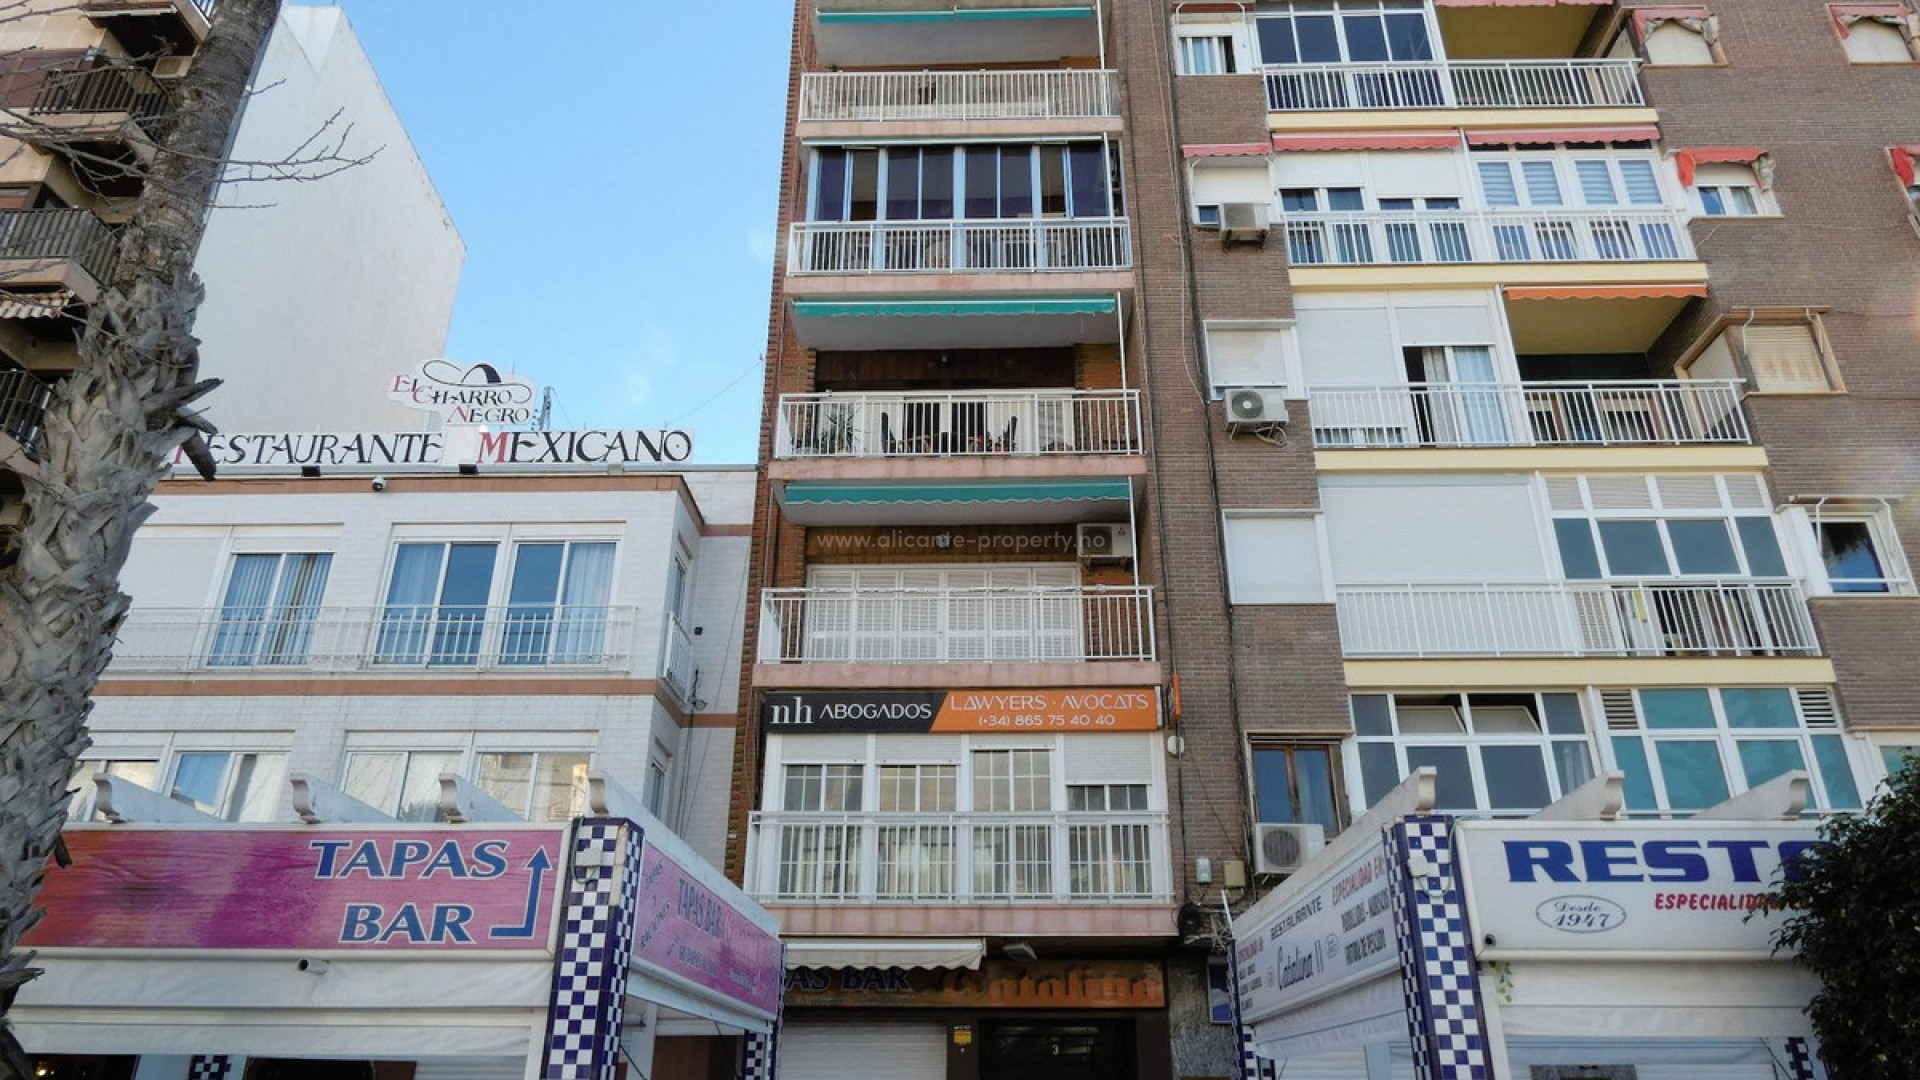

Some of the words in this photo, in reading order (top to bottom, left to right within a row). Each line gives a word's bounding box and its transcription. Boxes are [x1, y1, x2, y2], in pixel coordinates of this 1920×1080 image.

[412, 384, 513, 405] CHARRO
[446, 404, 530, 423] NEGRO
[476, 429, 692, 464] MEXICANO
[769, 696, 813, 725] nh
[819, 703, 932, 719] ABOGADOS
[951, 694, 1047, 711] LAWYERS
[1060, 693, 1148, 710] AVOCATS
[1015, 716, 1043, 727] 865
[1048, 715, 1065, 726] 75
[1070, 715, 1090, 726] 40
[1095, 715, 1115, 726] 40
[309, 840, 510, 880] TAPAS
[677, 878, 704, 929] TAPAS
[338, 902, 478, 944] BAR
[1270, 896, 1323, 940] RESTAURANTE
[1553, 913, 1610, 927] 1947
[840, 966, 913, 991] BAR
